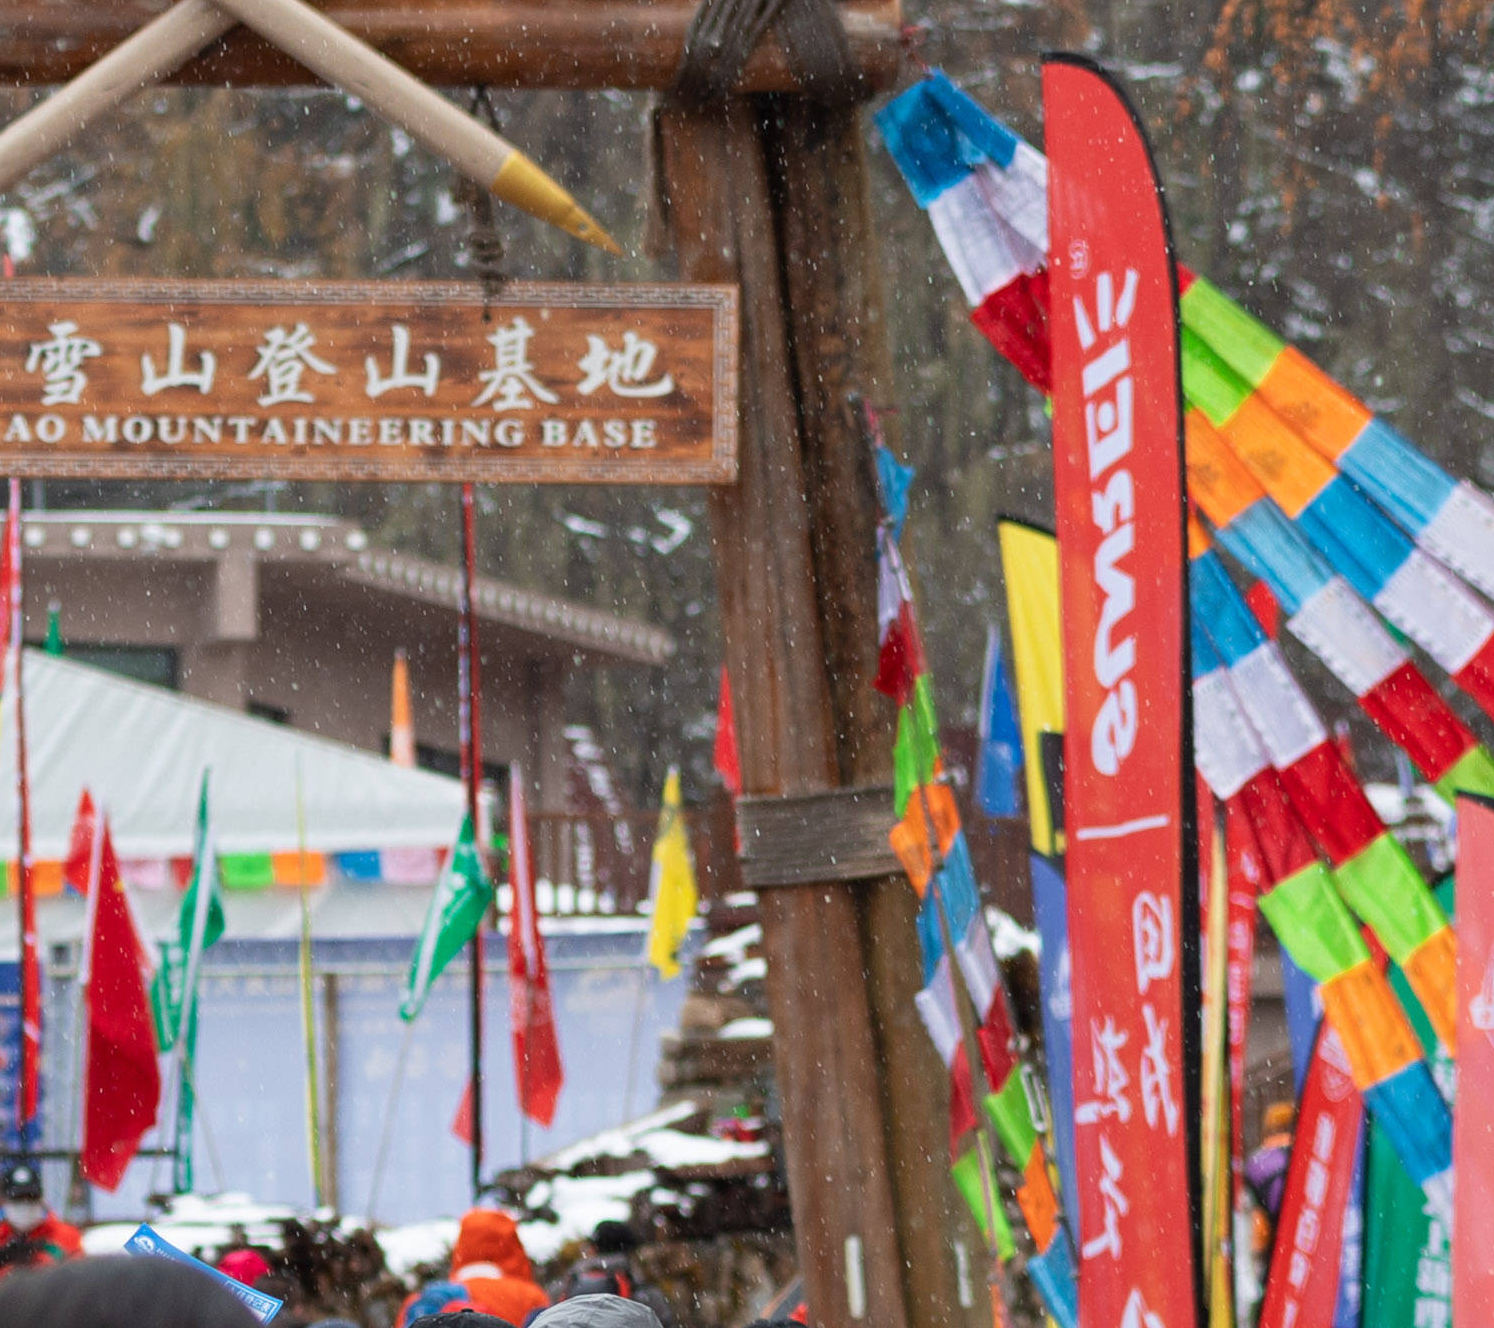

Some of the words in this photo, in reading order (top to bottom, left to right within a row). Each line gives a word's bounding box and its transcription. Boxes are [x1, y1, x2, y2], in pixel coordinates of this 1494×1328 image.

[0, 414, 67, 445] AO
[79, 414, 528, 450] MOUNTAINEERING
[539, 418, 659, 450] BASE
